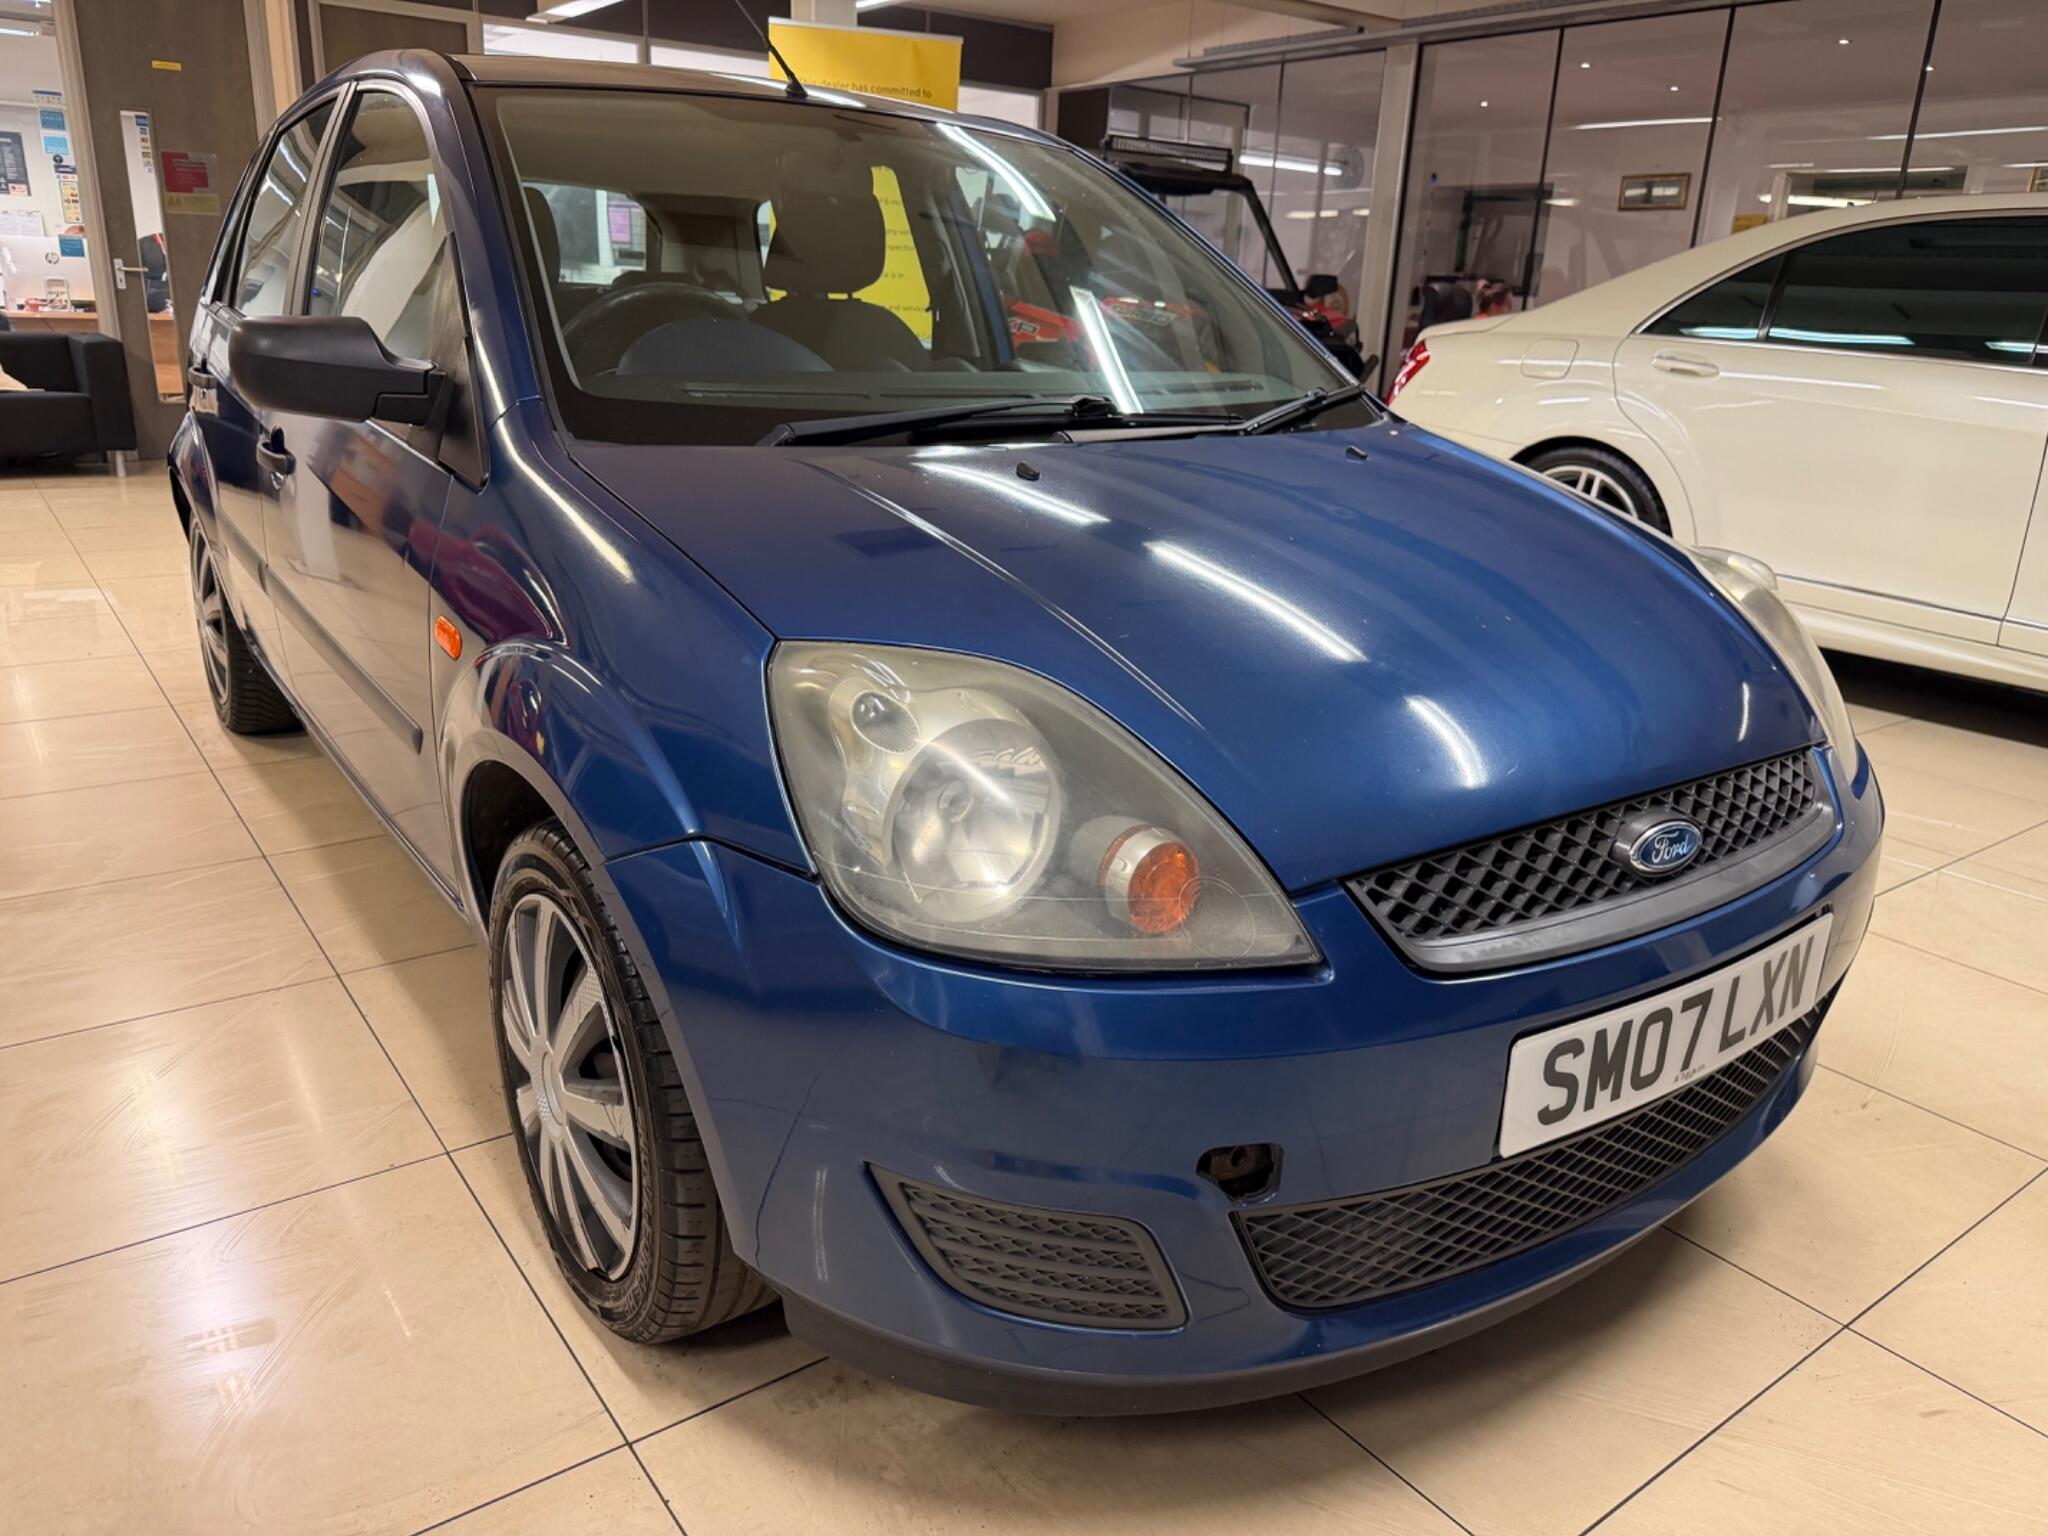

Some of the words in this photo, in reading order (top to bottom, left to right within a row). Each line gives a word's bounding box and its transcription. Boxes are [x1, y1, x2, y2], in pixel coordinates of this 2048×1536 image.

[852, 82, 868, 93] has
[870, 84, 920, 96] committed
[922, 88, 933, 99] to
[1651, 830, 1694, 864] Ford
